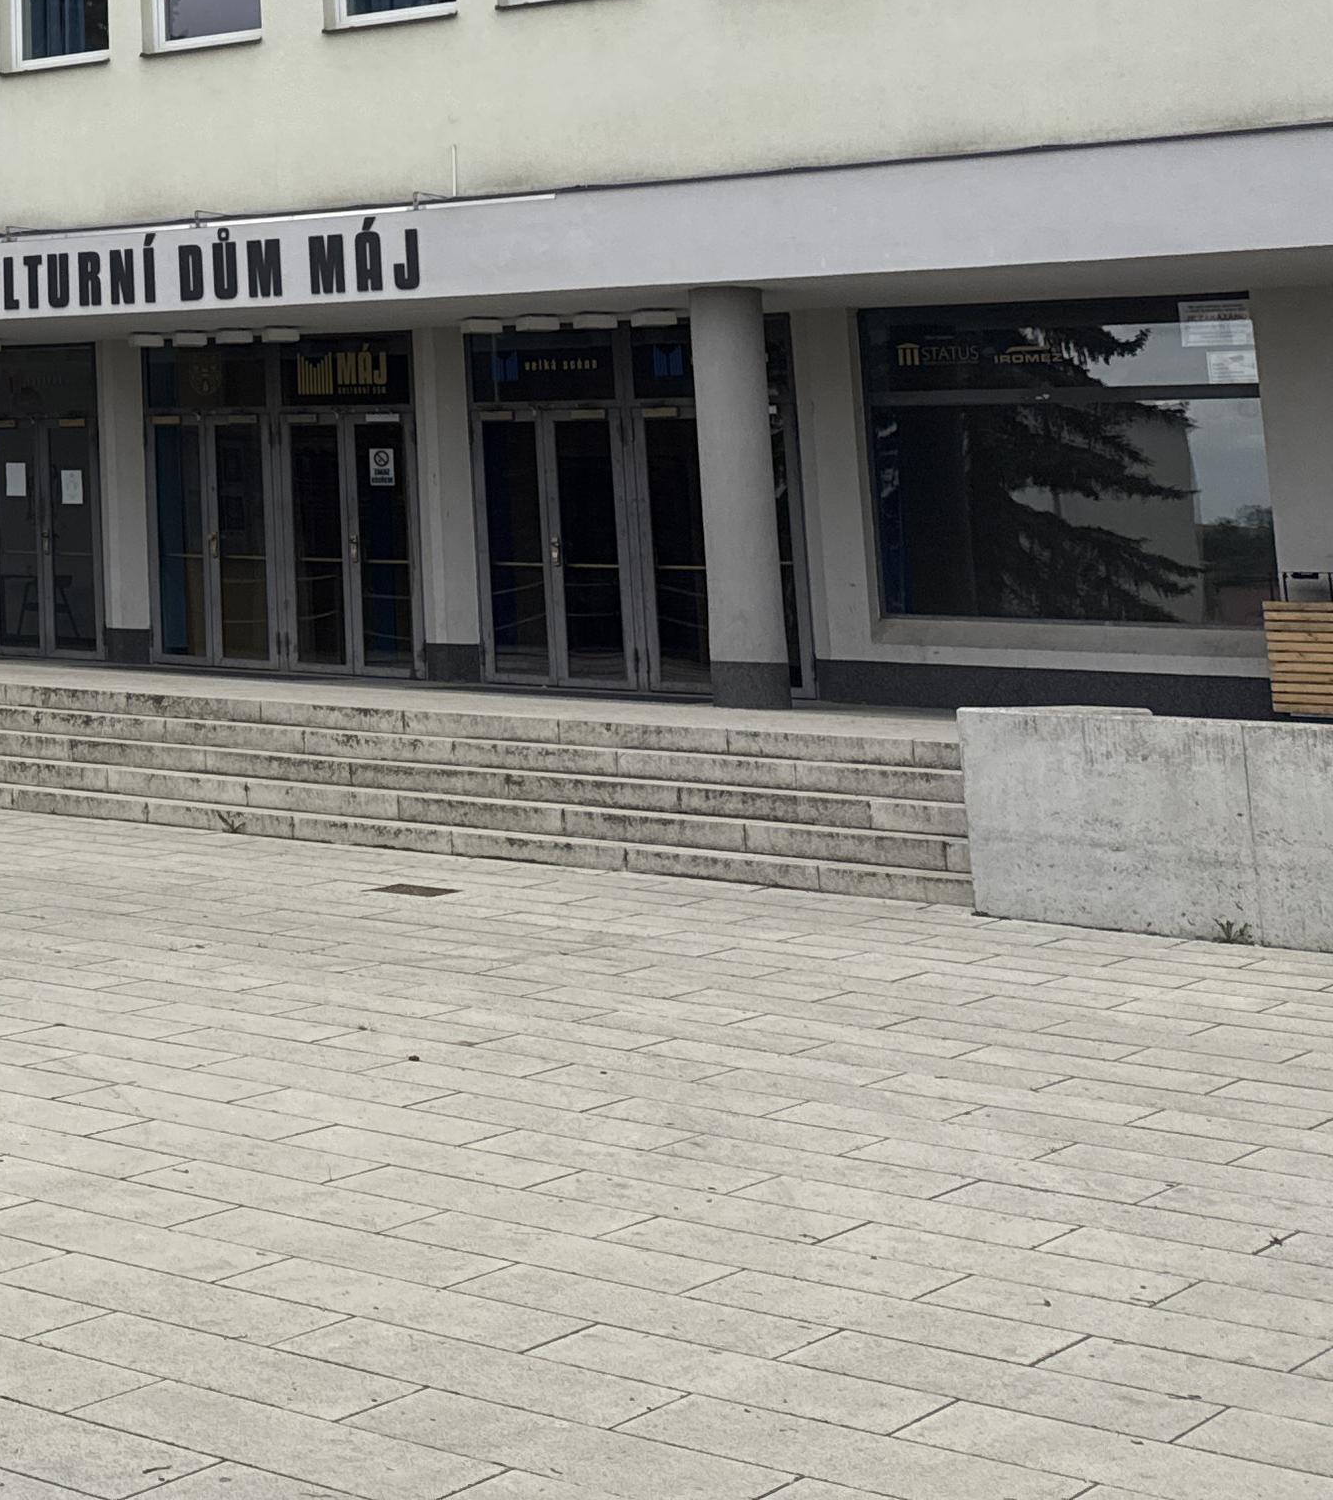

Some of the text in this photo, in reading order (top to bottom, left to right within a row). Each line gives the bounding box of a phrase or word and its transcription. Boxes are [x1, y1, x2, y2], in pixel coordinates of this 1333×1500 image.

[177, 227, 284, 301] DŮM
[307, 216, 421, 297] MÁJ
[336, 342, 388, 385] MÁJ
[920, 345, 980, 361] STATUS
[994, 353, 1064, 364] IROMEZ
